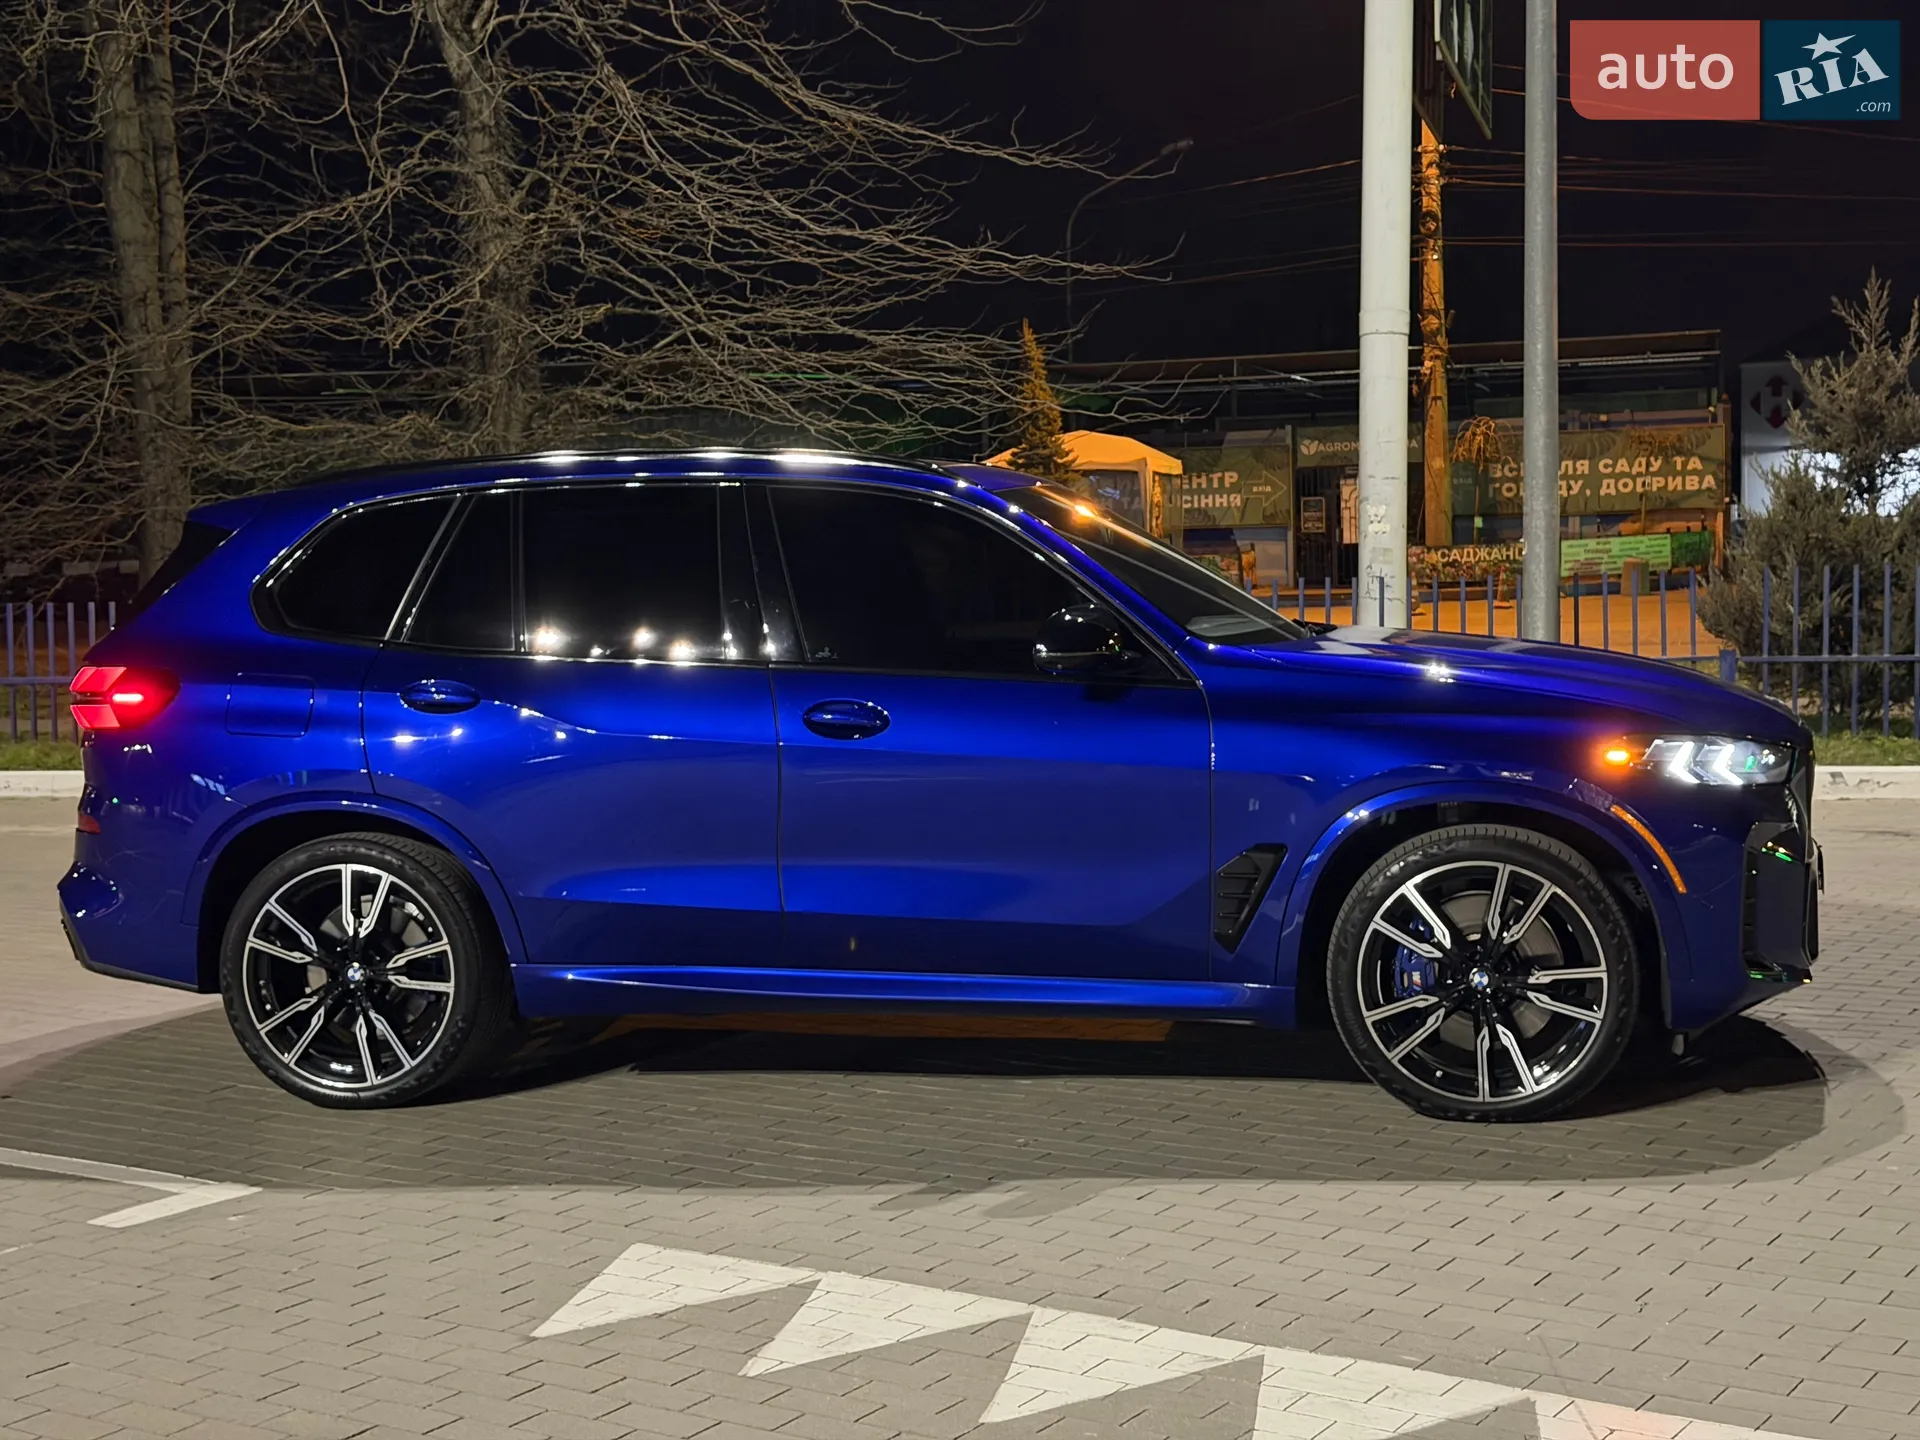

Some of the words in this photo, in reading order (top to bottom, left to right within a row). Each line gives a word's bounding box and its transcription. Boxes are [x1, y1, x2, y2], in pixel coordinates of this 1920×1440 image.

[1488, 462, 1524, 479] ВС
[1558, 460, 1590, 476] ЛЯ
[1598, 456, 1663, 476] САДУ
[1673, 455, 1704, 471] ТА
[1165, 472, 1239, 490] ЕНТР
